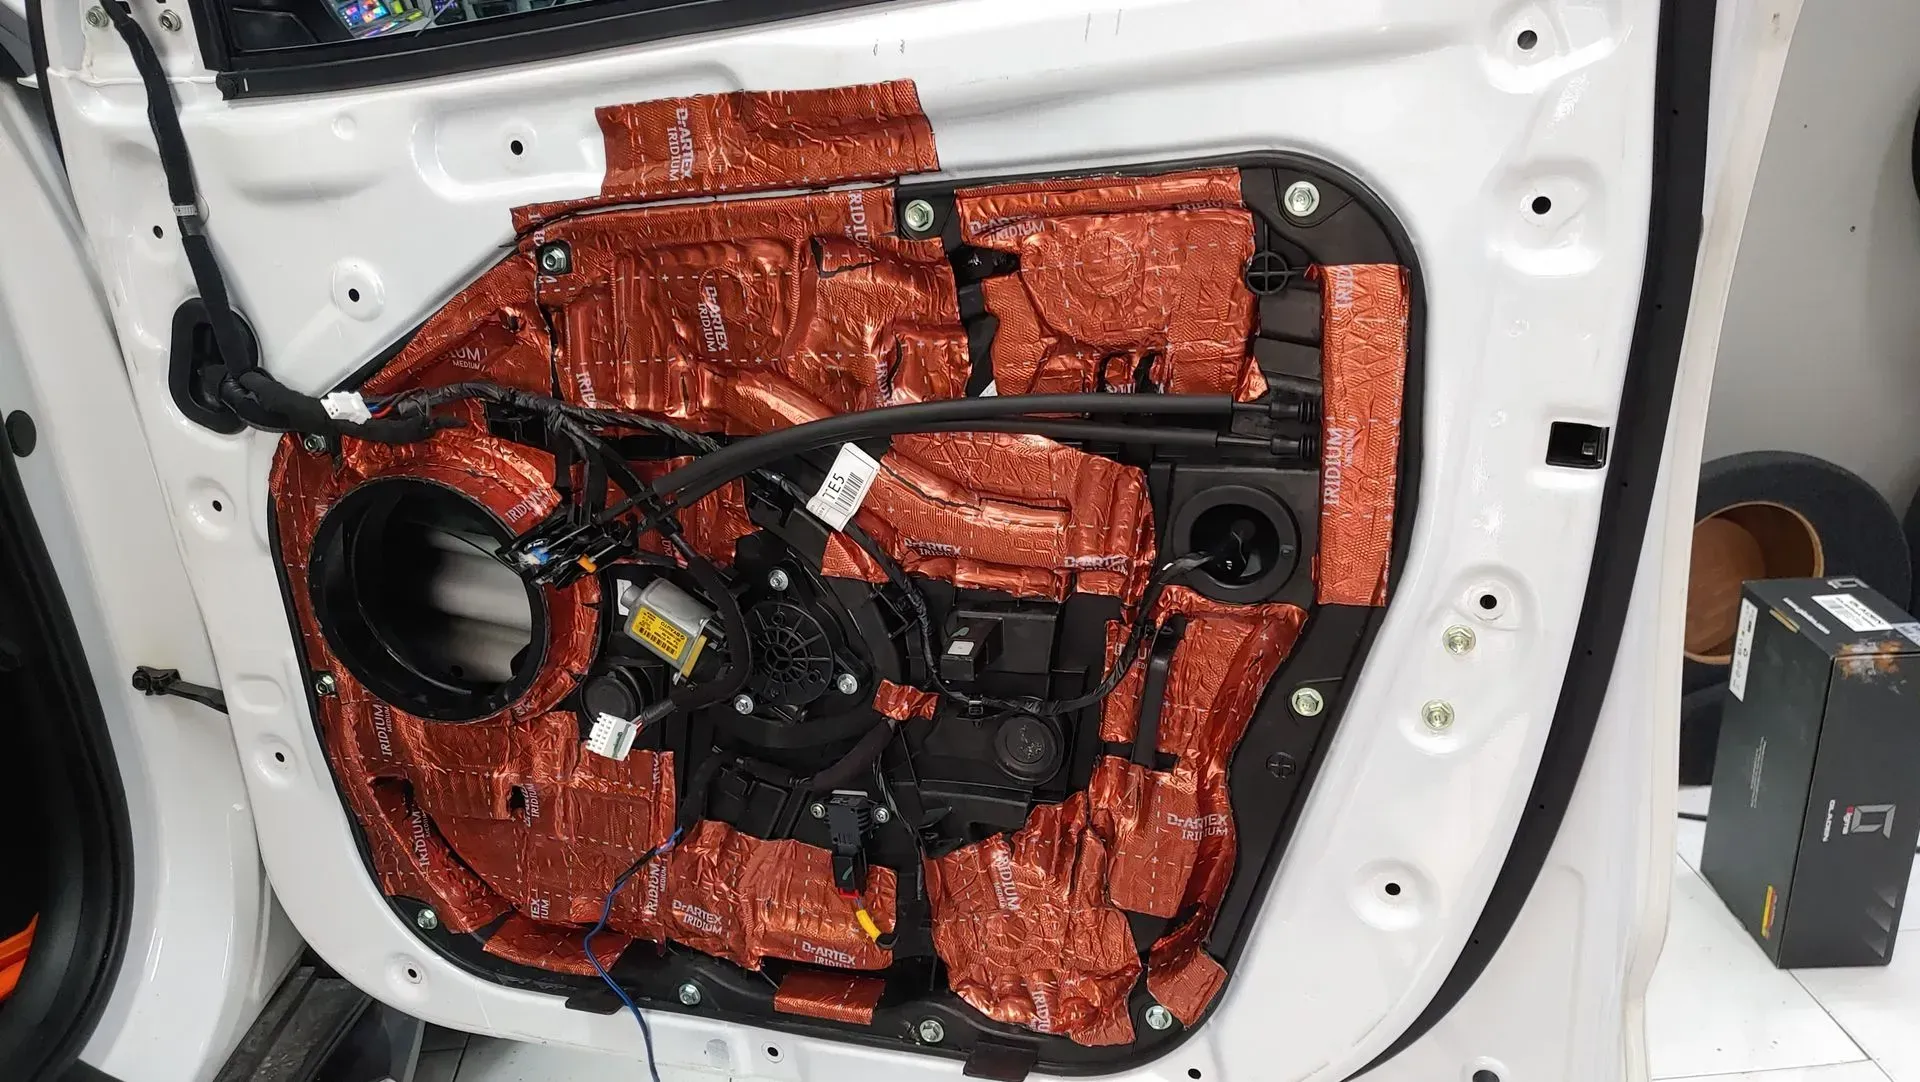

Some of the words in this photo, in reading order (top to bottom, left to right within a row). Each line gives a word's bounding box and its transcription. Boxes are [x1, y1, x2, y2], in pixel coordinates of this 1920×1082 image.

[667, 126, 680, 181] IRIDIUM
[676, 108, 693, 180] DrARTEX
[697, 302, 717, 352] IRIDIUM
[452, 360, 480, 370] MEDIUM
[1324, 428, 1343, 505] IRIDIUM
[822, 473, 845, 500] TE5
[372, 704, 393, 757] IRIDIUM
[384, 706, 393, 733] MEDIUM
[525, 783, 540, 818] IRIDIUM
[643, 862, 661, 917] IRIDIUM
[672, 899, 723, 925] DrARTEX
[682, 913, 722, 935] IRIDIUM
[801, 941, 856, 966] DrARTEX
